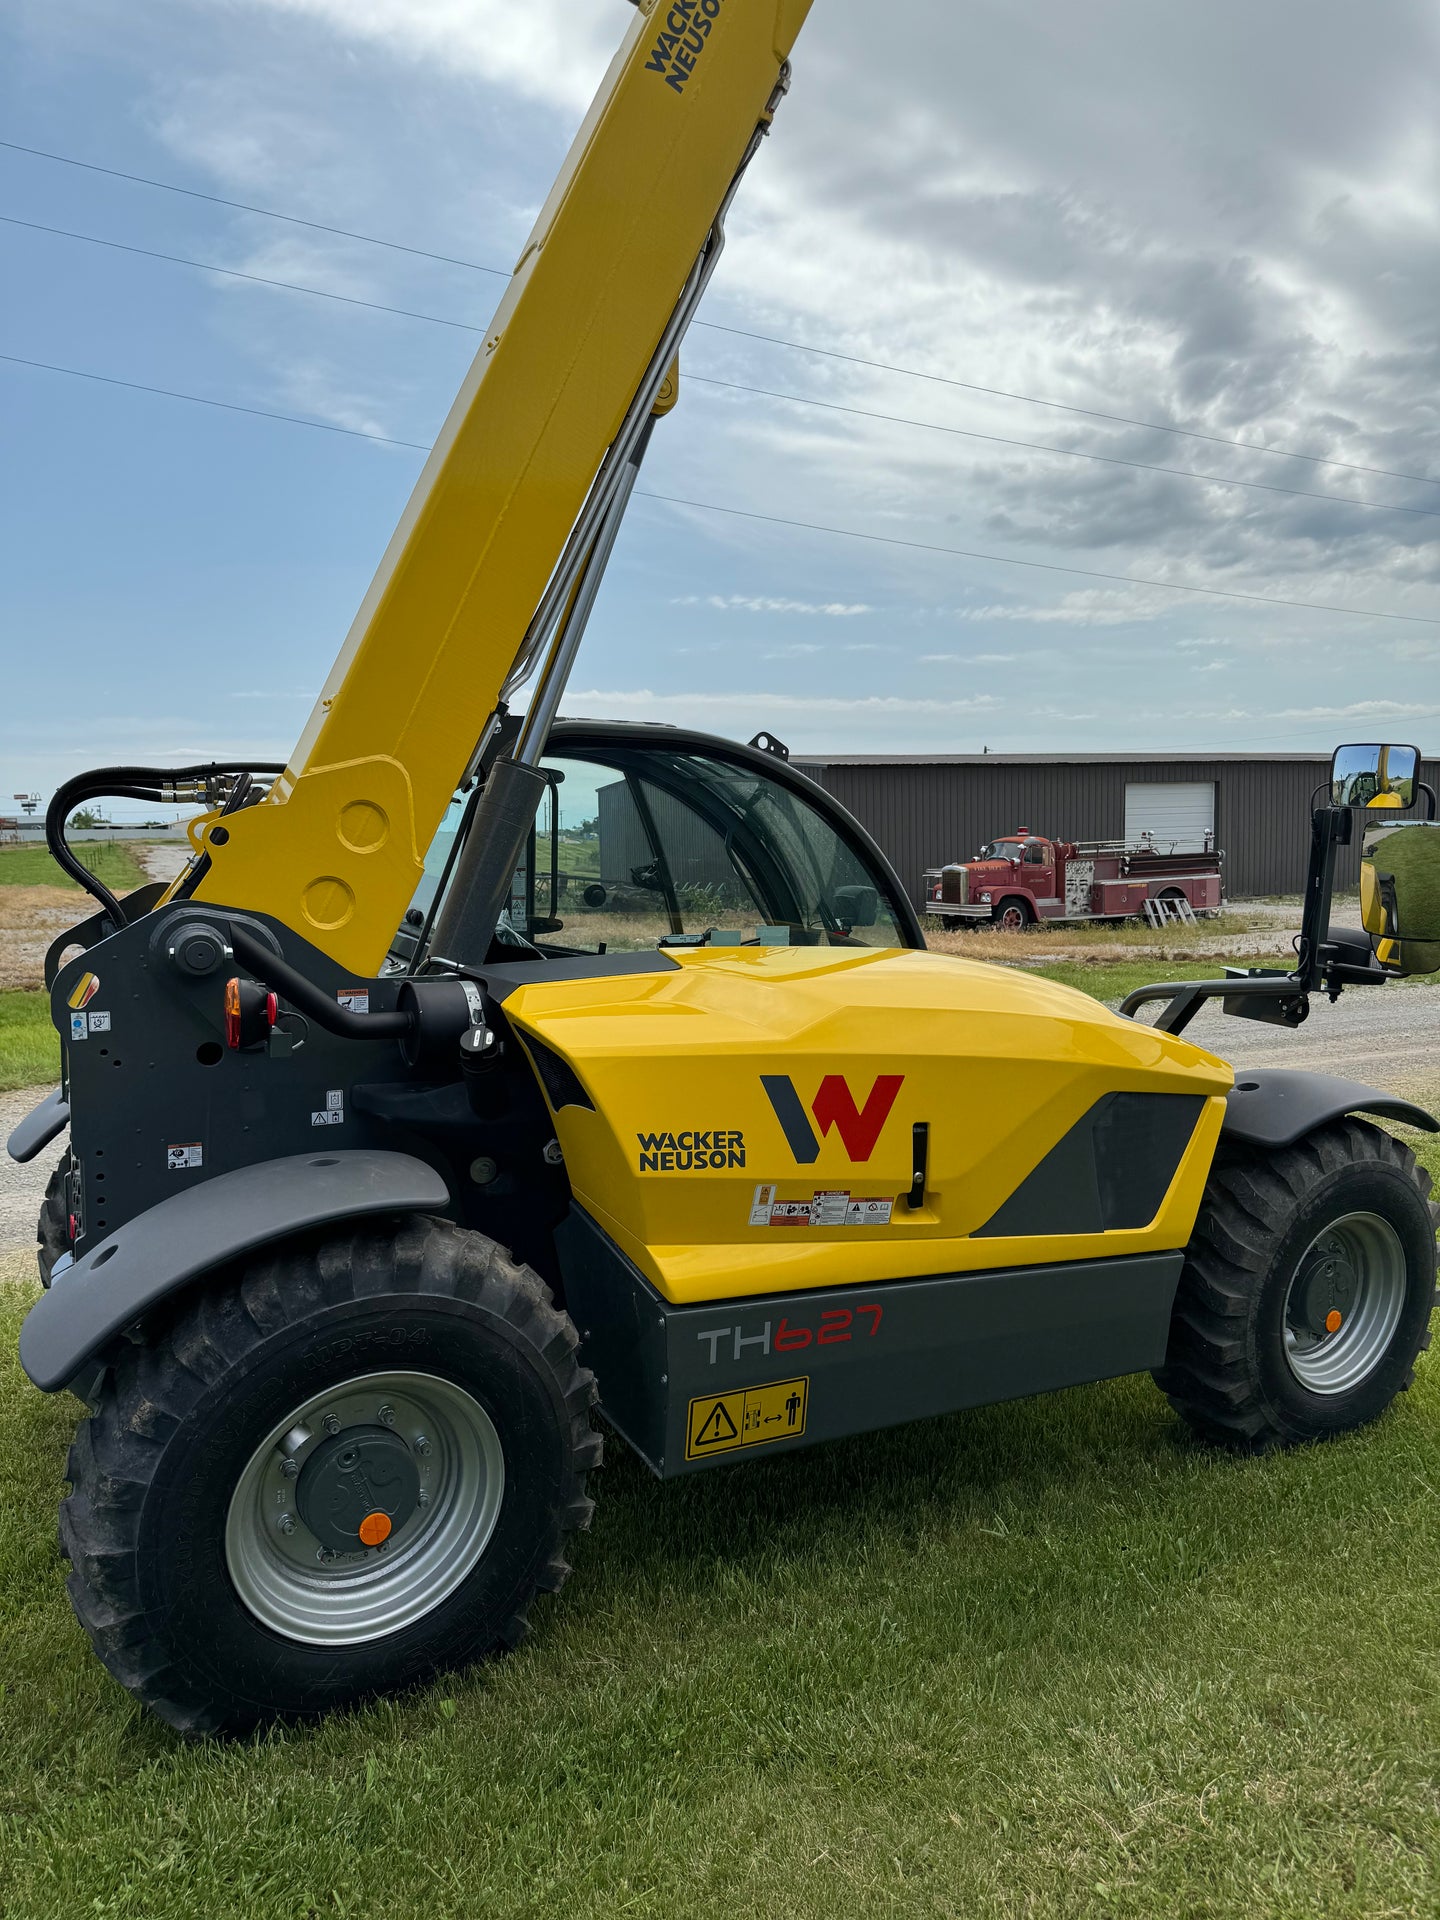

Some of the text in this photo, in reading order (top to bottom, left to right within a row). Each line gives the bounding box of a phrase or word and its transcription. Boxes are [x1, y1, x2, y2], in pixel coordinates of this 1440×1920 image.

[645, 0, 699, 73] WACK
[665, 0, 724, 94] NEUSO
[636, 1131, 745, 1151] WACKER
[640, 1150, 746, 1171] NEUSON
[697, 1303, 884, 1364] TH627
